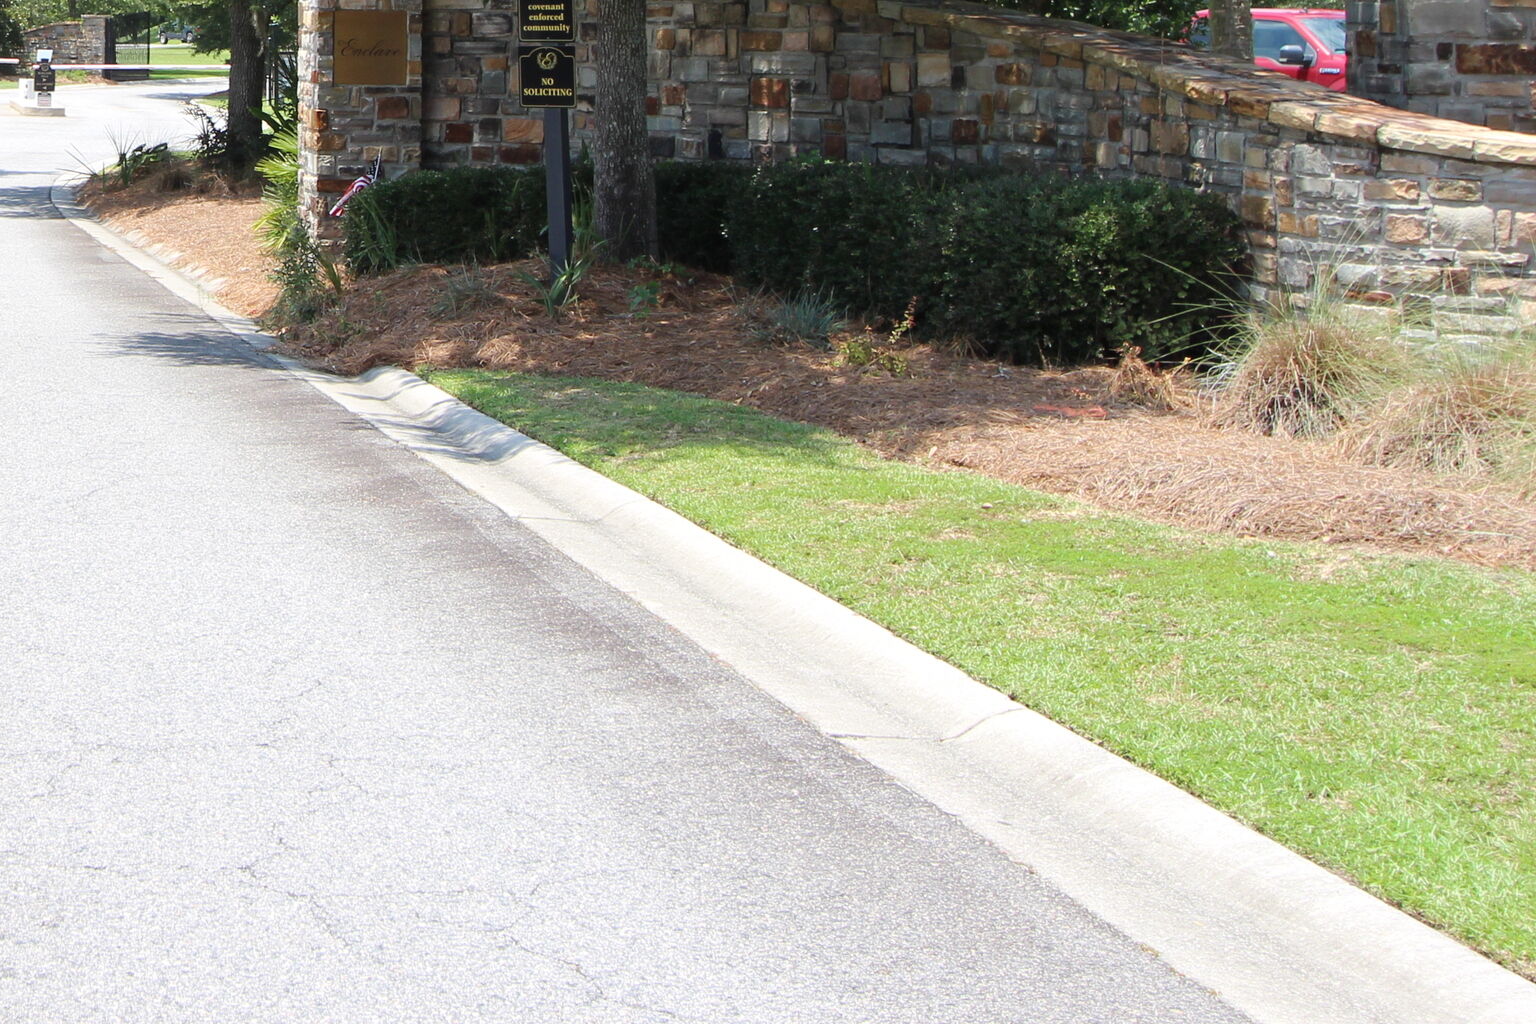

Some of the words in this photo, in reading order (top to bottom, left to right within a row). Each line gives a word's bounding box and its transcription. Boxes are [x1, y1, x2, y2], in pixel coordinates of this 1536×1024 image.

[527, 3, 564, 11] covenant
[528, 13, 564, 21] enforced
[523, 24, 570, 34] community
[341, 38, 401, 57] Enclave
[541, 78, 554, 86] NO
[523, 88, 573, 97] SOLICITING
